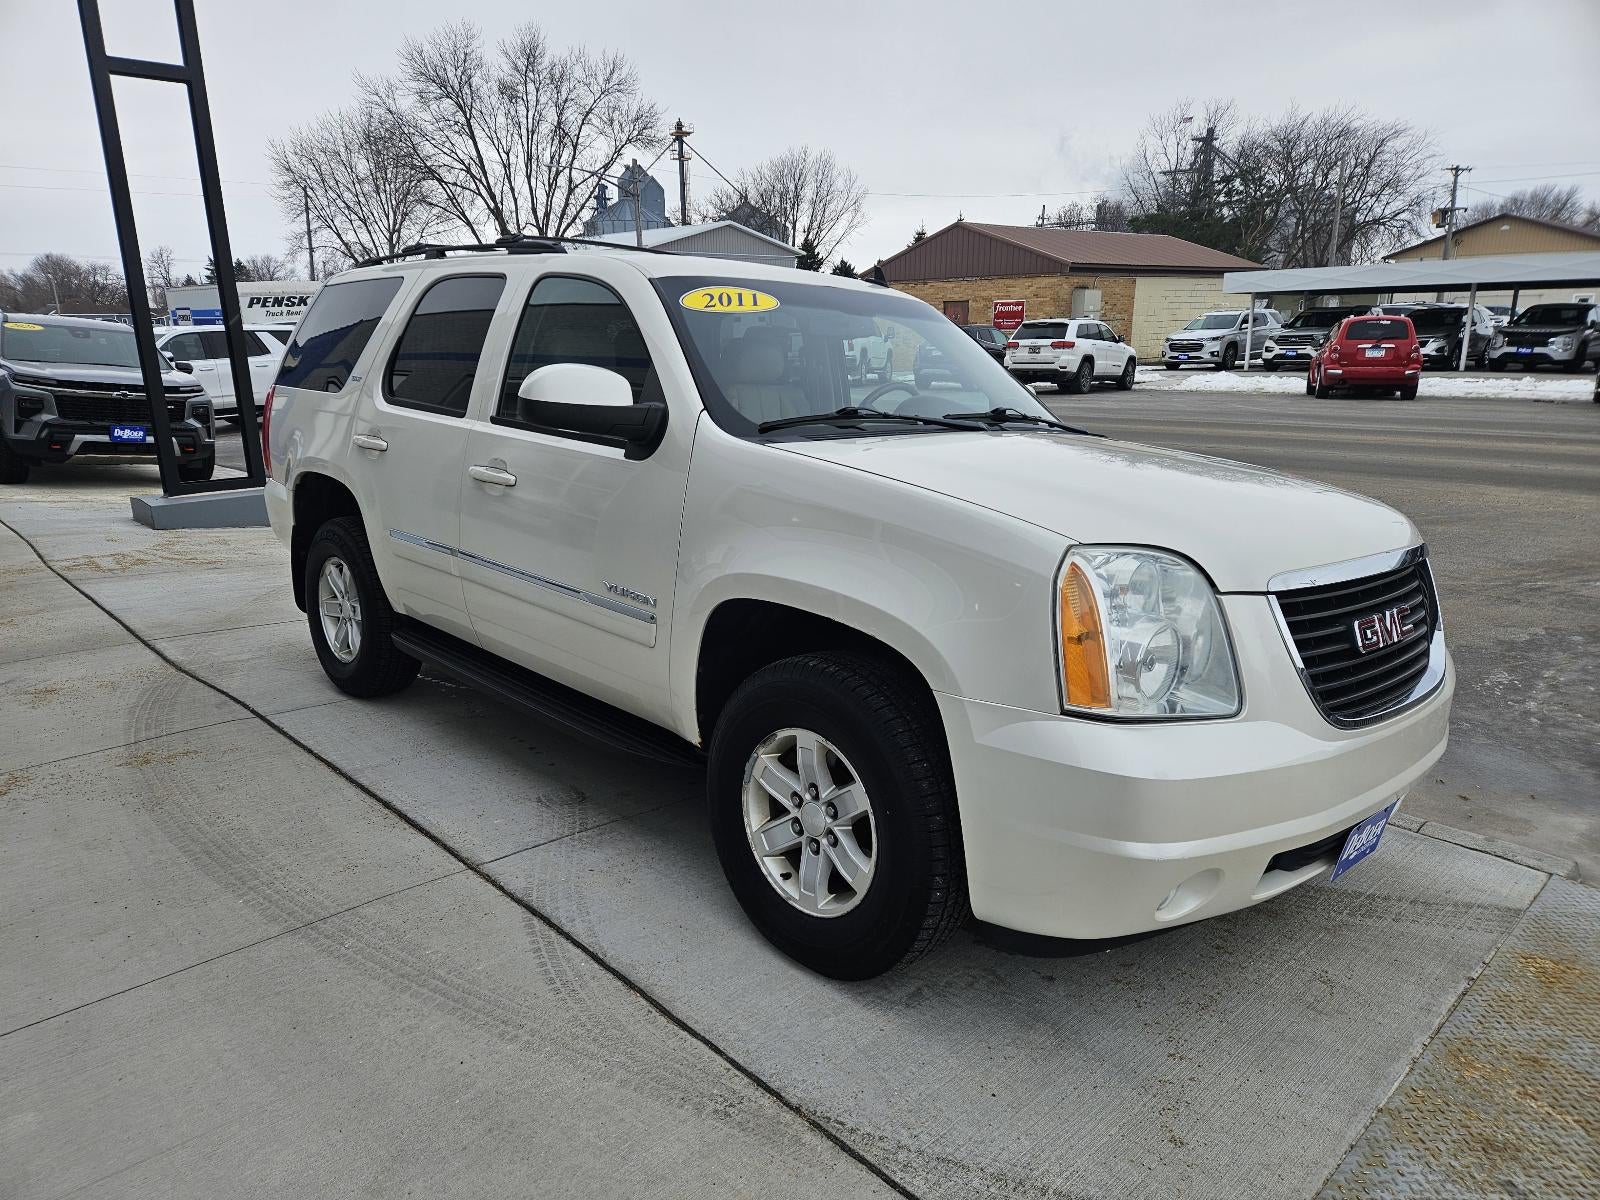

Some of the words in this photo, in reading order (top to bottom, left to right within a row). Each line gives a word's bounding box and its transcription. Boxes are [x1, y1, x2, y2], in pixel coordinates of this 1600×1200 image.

[247, 295, 313, 308] PENSK
[701, 292, 760, 308] 2011
[994, 303, 1023, 314] frontier
[602, 580, 657, 608] YUKON
[1353, 605, 1415, 654] GMC
